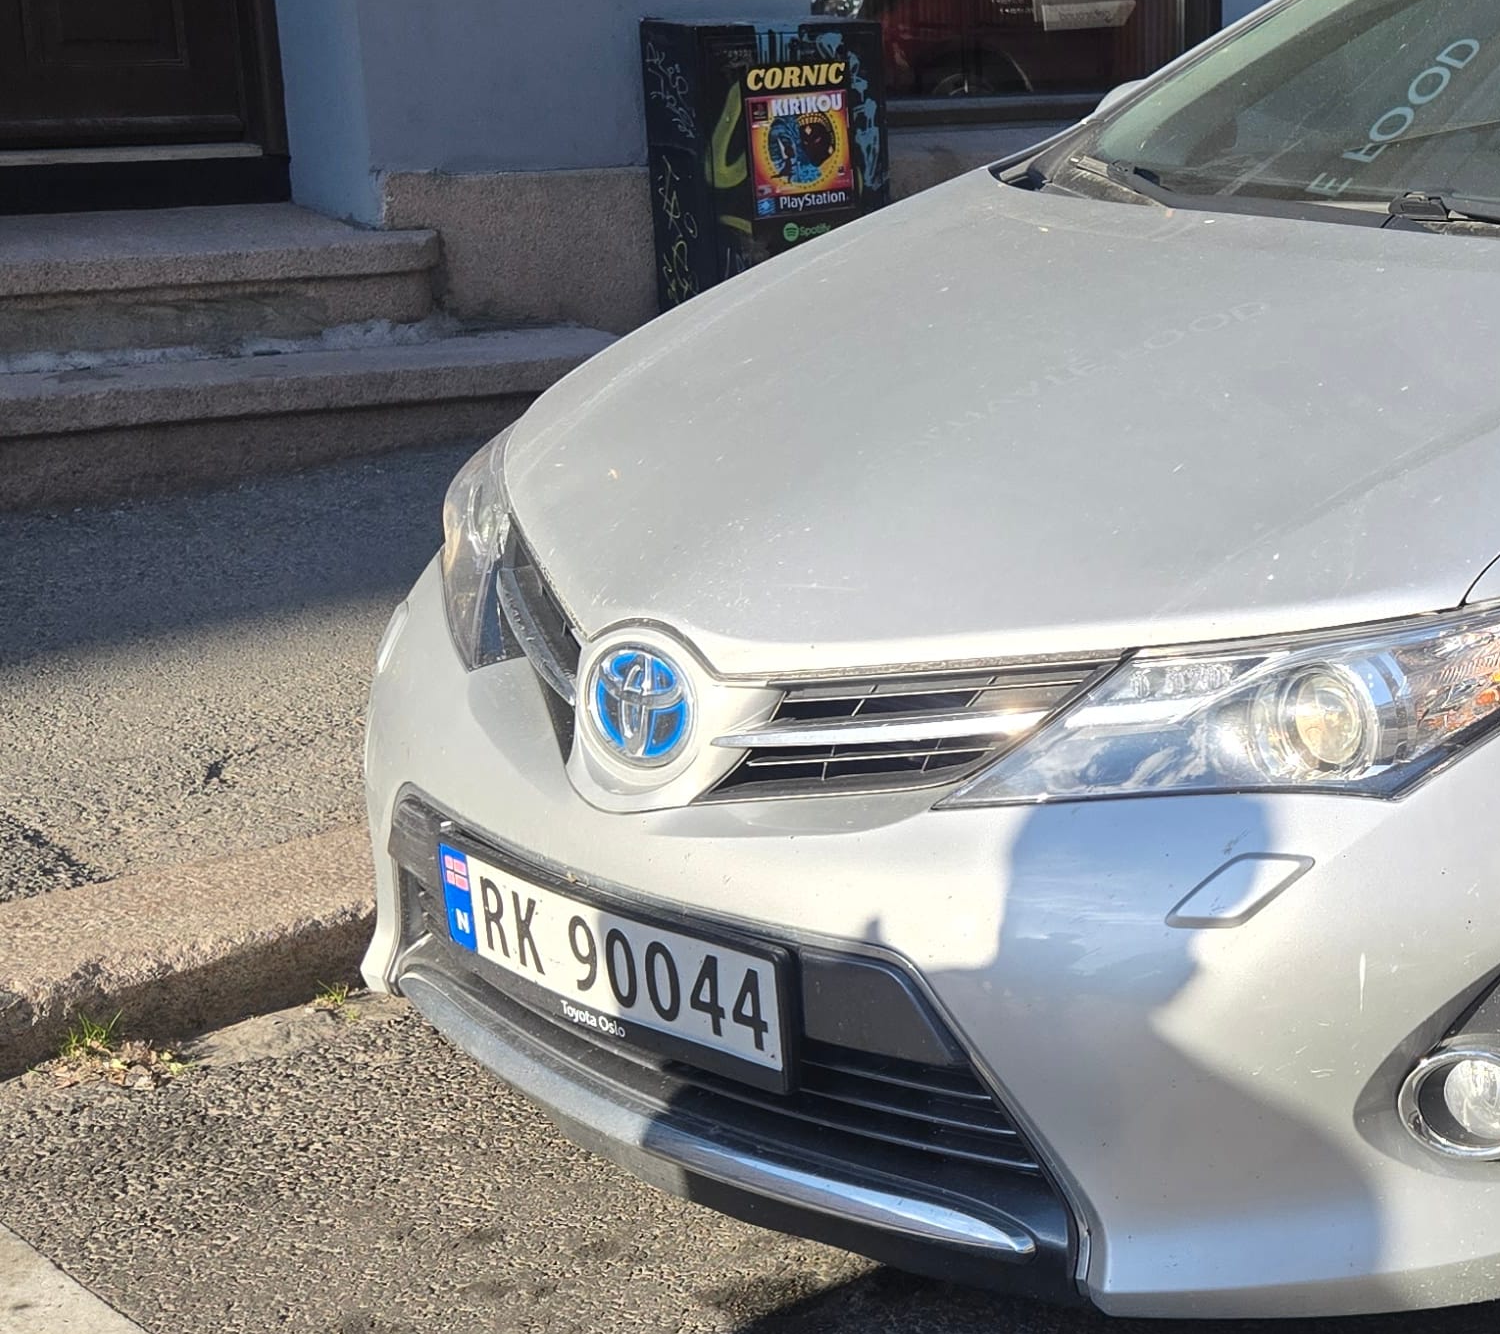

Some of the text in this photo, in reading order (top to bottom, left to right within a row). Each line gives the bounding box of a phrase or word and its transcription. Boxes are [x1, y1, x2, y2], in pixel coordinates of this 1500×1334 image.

[746, 62, 846, 91] CORNIC
[771, 93, 843, 117] KIRIKOU
[779, 191, 846, 211] PlayStation
[455, 908, 470, 934] N
[480, 875, 769, 1051] RK 90044
[560, 999, 626, 1038] Toyota Oslo
